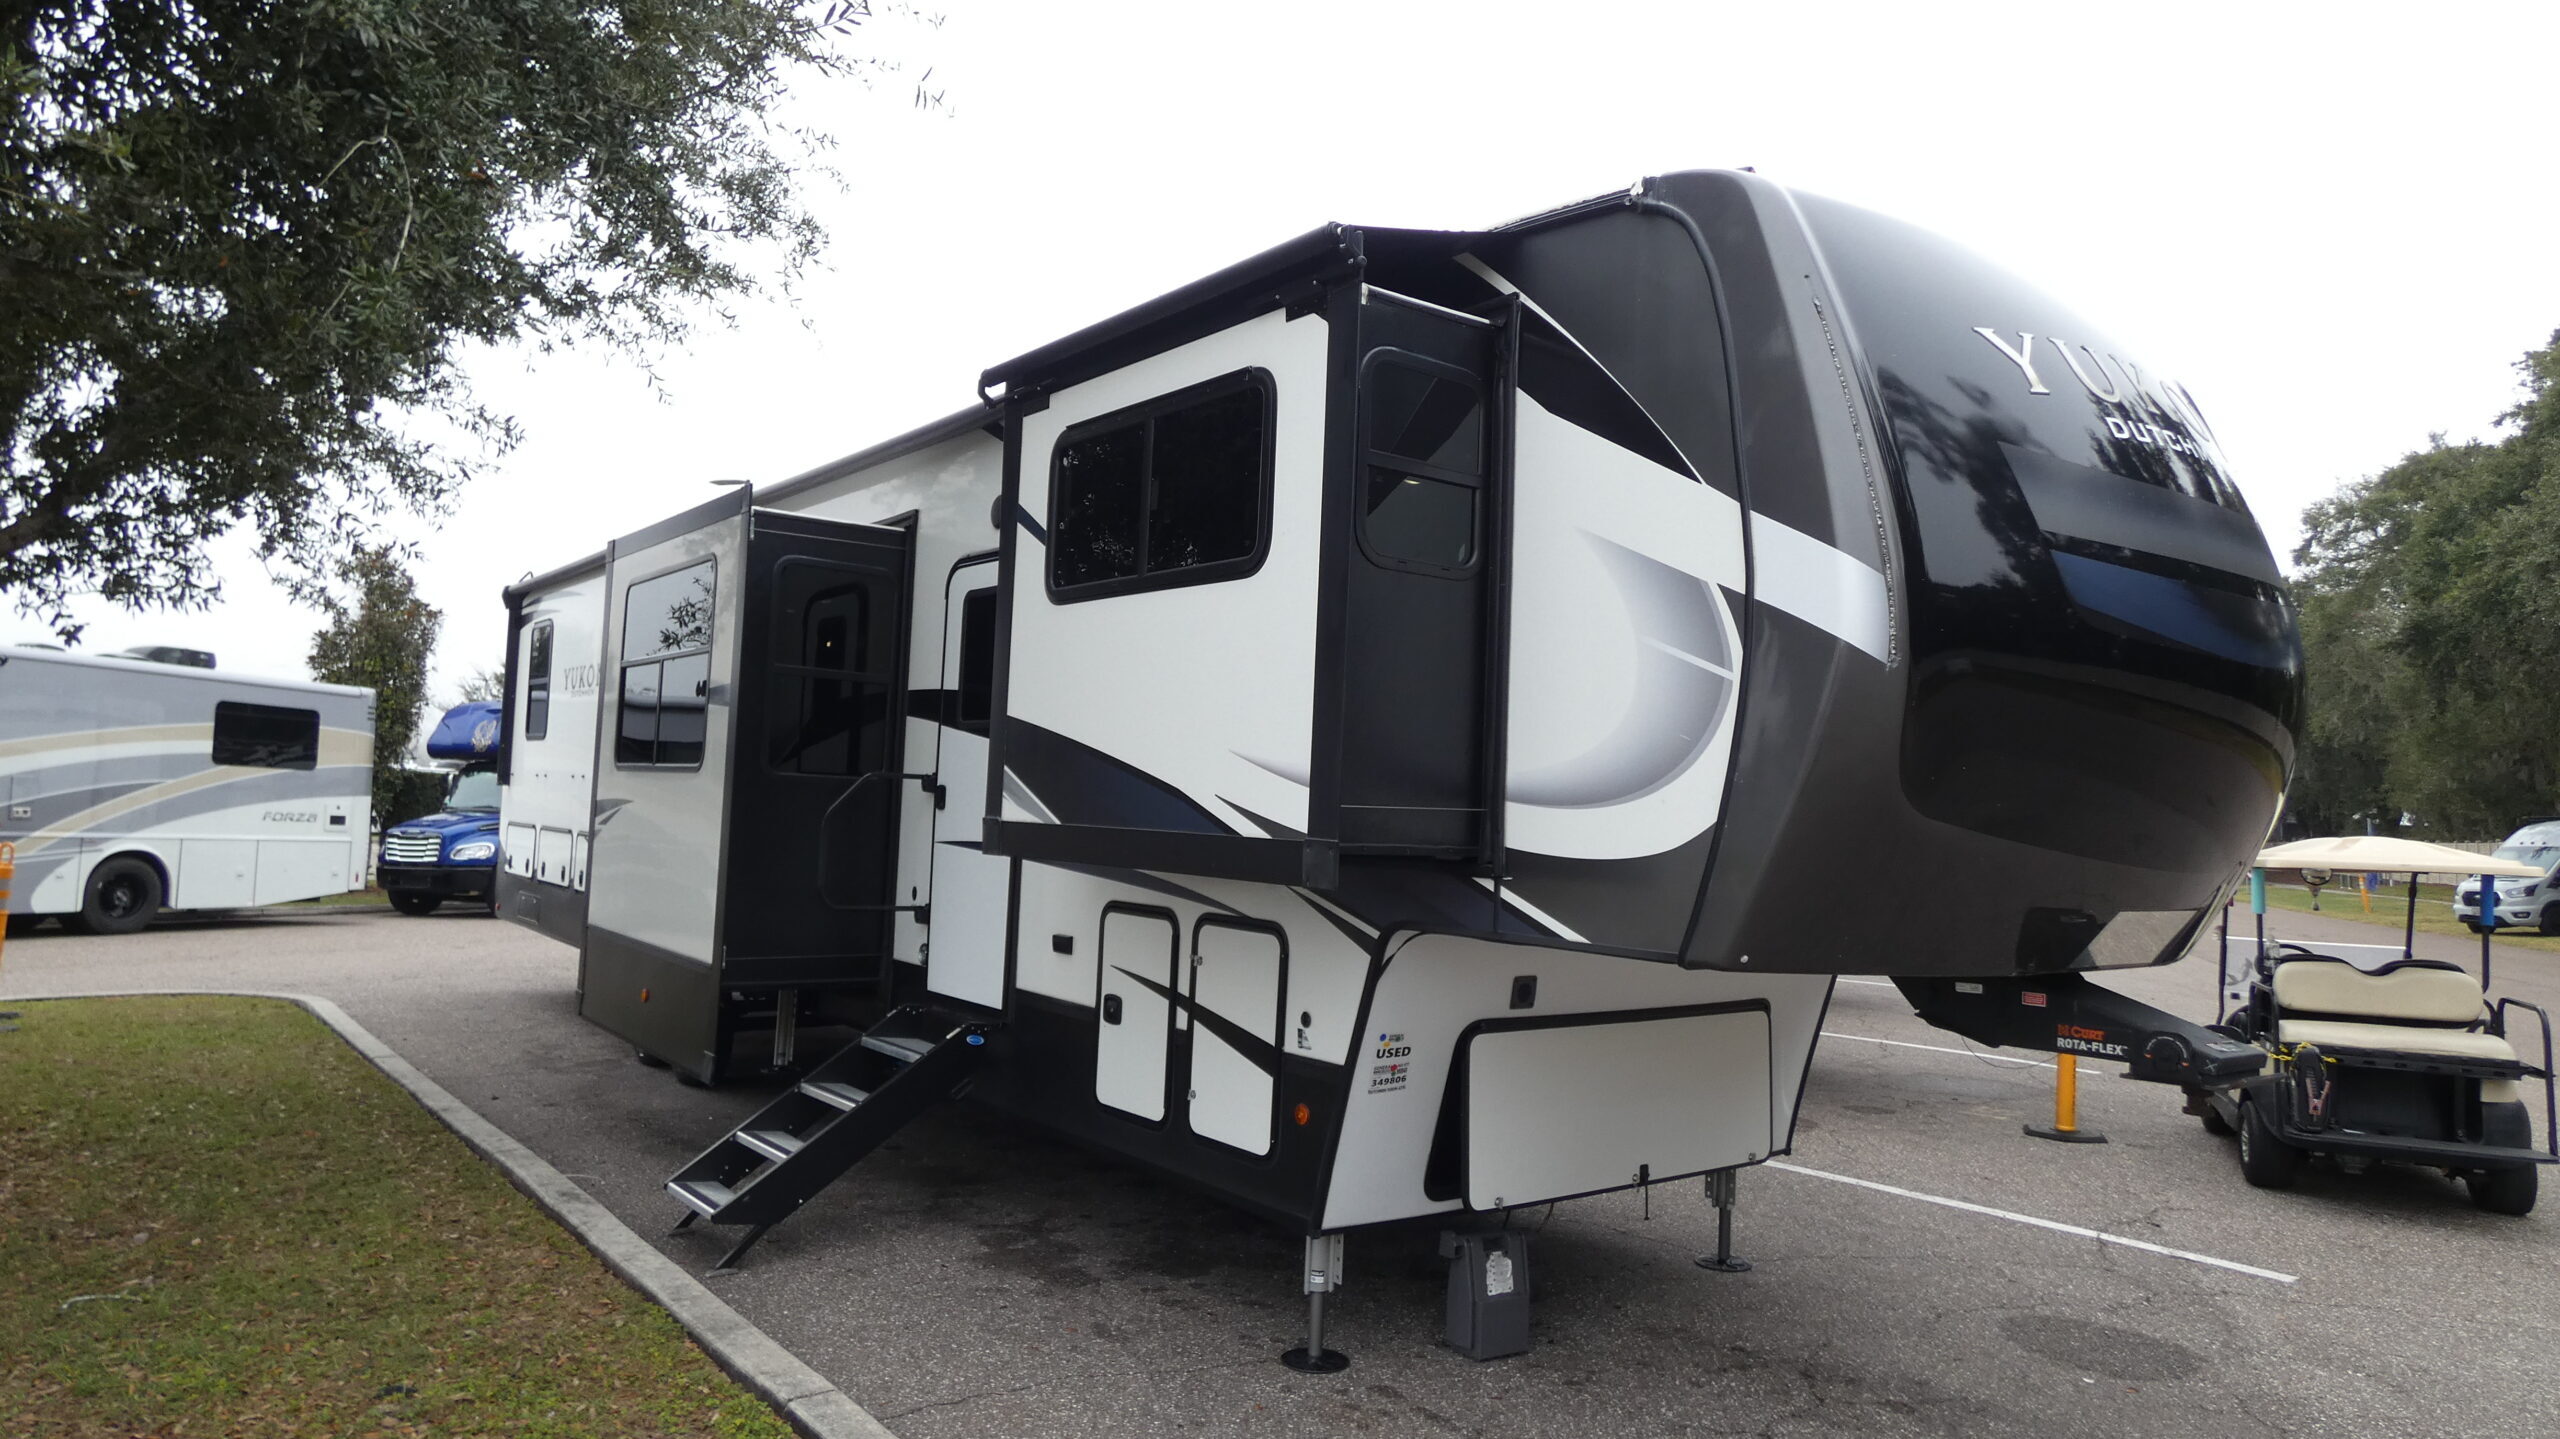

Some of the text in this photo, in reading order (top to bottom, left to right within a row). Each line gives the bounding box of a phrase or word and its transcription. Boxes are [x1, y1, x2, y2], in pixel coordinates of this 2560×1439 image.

[2070, 1025, 2105, 1041] CURT
[1376, 1046, 1411, 1059] USED
[2056, 1036, 2124, 1056] ROTA-FLEX
[1371, 1075, 1407, 1087] 349806
